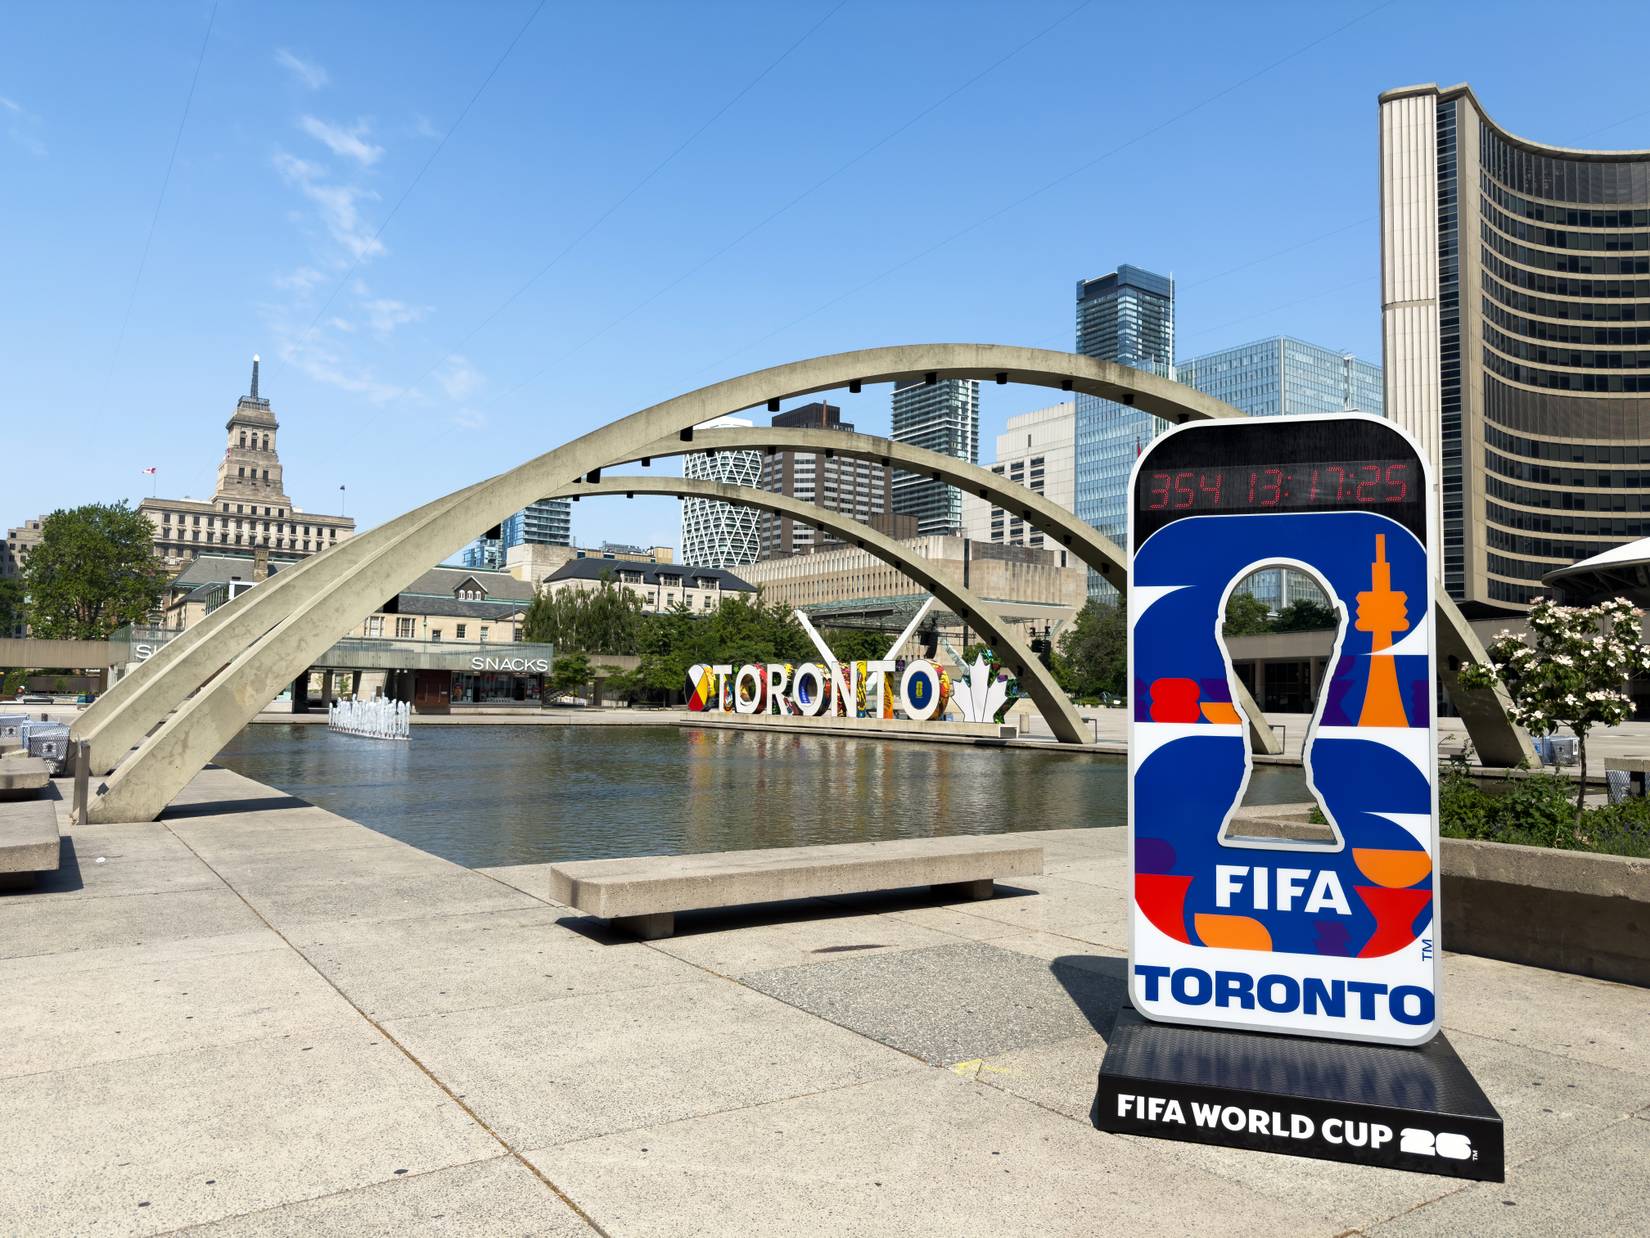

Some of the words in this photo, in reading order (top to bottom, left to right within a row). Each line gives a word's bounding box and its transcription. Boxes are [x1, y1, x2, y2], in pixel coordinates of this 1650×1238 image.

[1149, 472, 1224, 511] 354
[471, 657, 548, 672] SNACKS
[712, 659, 941, 721] TORONTO
[1215, 864, 1352, 915] FIFA
[1422, 939, 1432, 961] TM
[1134, 964, 1435, 1026] TORONTO
[1117, 1094, 1186, 1126] FIFA
[1190, 1103, 1315, 1140] WORLD
[1321, 1119, 1393, 1150] CUP
[1400, 1128, 1471, 1160] 26
